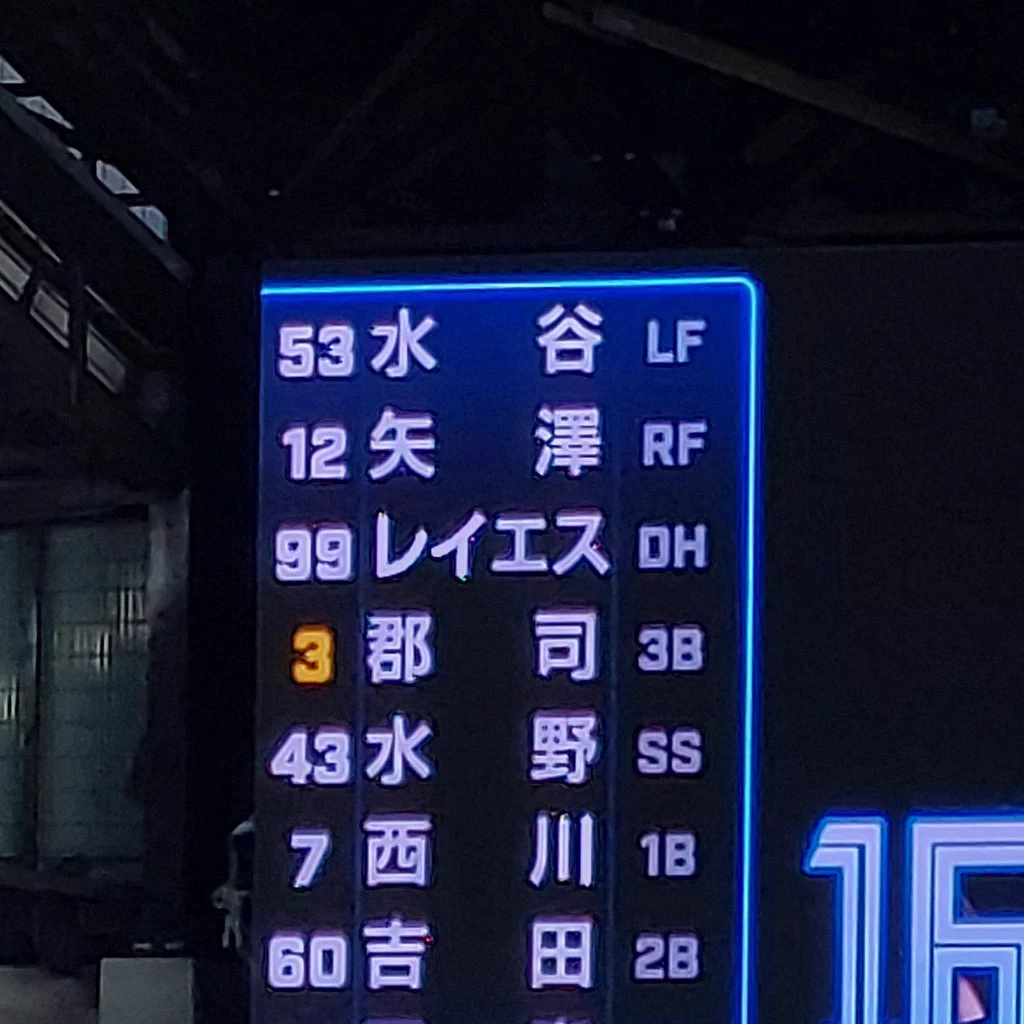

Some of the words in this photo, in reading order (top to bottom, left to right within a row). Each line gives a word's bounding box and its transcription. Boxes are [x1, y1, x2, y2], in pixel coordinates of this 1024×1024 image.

[278, 323, 355, 379] 53
[647, 319, 705, 364] LF
[281, 425, 348, 481] 12
[643, 421, 706, 467] RF
[274, 526, 353, 582] 99
[638, 523, 706, 569] DH
[292, 625, 334, 685] 3
[637, 626, 703, 672] 3B
[269, 729, 351, 786] 43
[637, 729, 701, 774] SS
[290, 832, 330, 889] 7
[640, 832, 695, 877] 1B
[267, 933, 348, 989] 60
[634, 935, 699, 980] 2B
